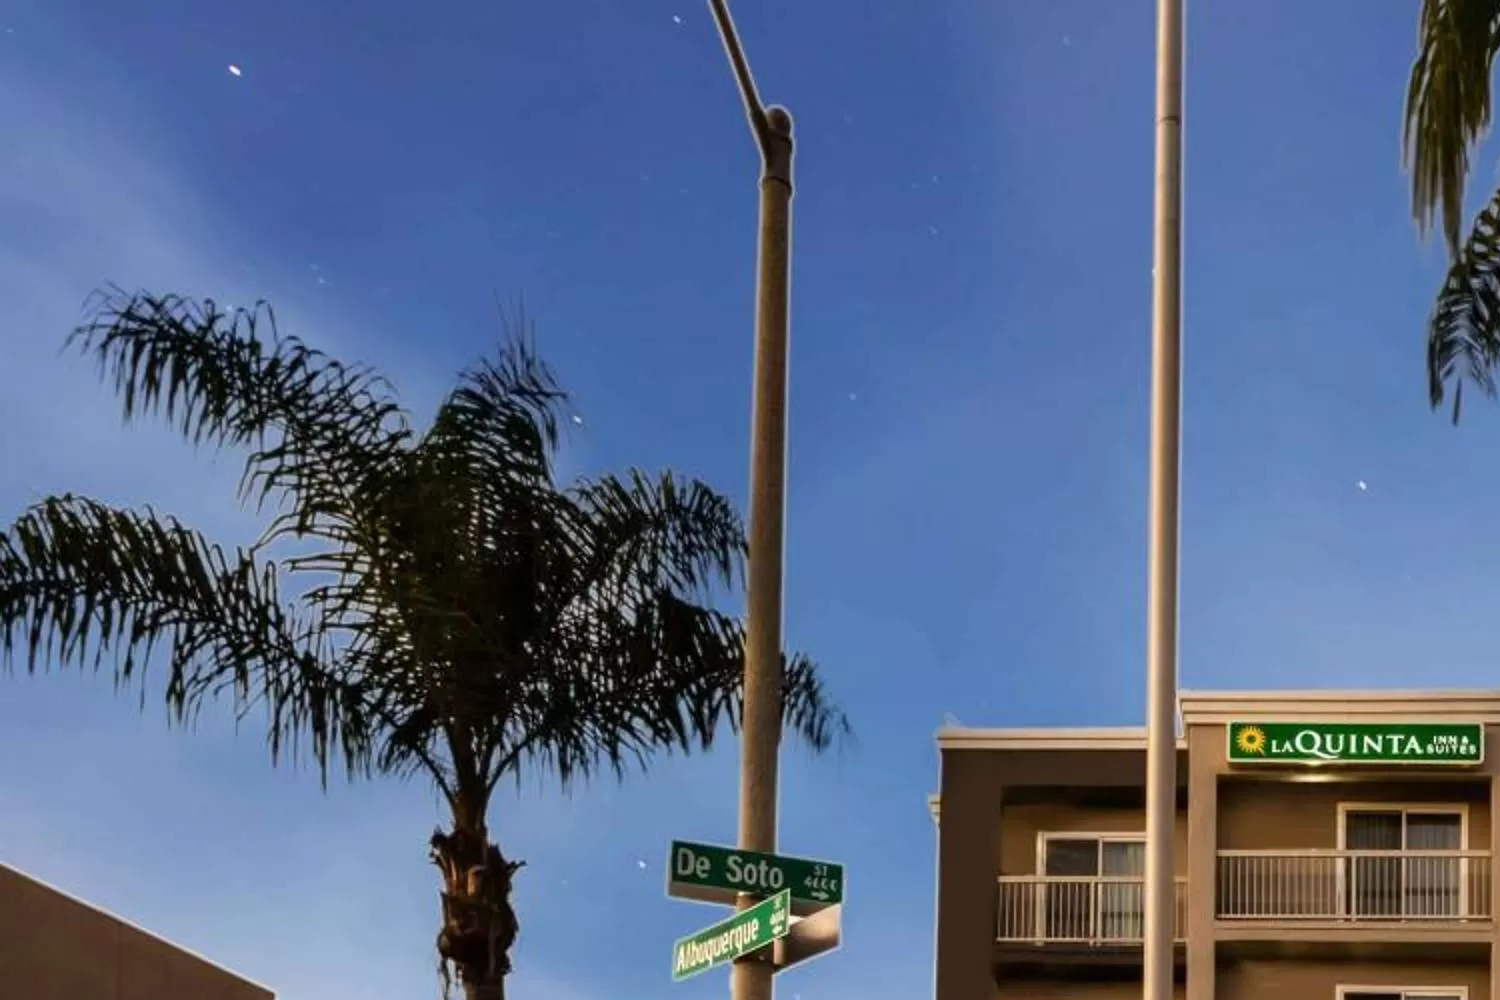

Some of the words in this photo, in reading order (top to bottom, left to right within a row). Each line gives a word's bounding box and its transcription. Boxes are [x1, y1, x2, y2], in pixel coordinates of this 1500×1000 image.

[1271, 740, 1297, 753] LA
[1295, 730, 1423, 759] QUINTA
[1426, 743, 1477, 755] SUITES
[1433, 735, 1457, 745] INN
[677, 847, 711, 878] De
[725, 855, 784, 888] Soto
[676, 917, 760, 966] Albuquerque
